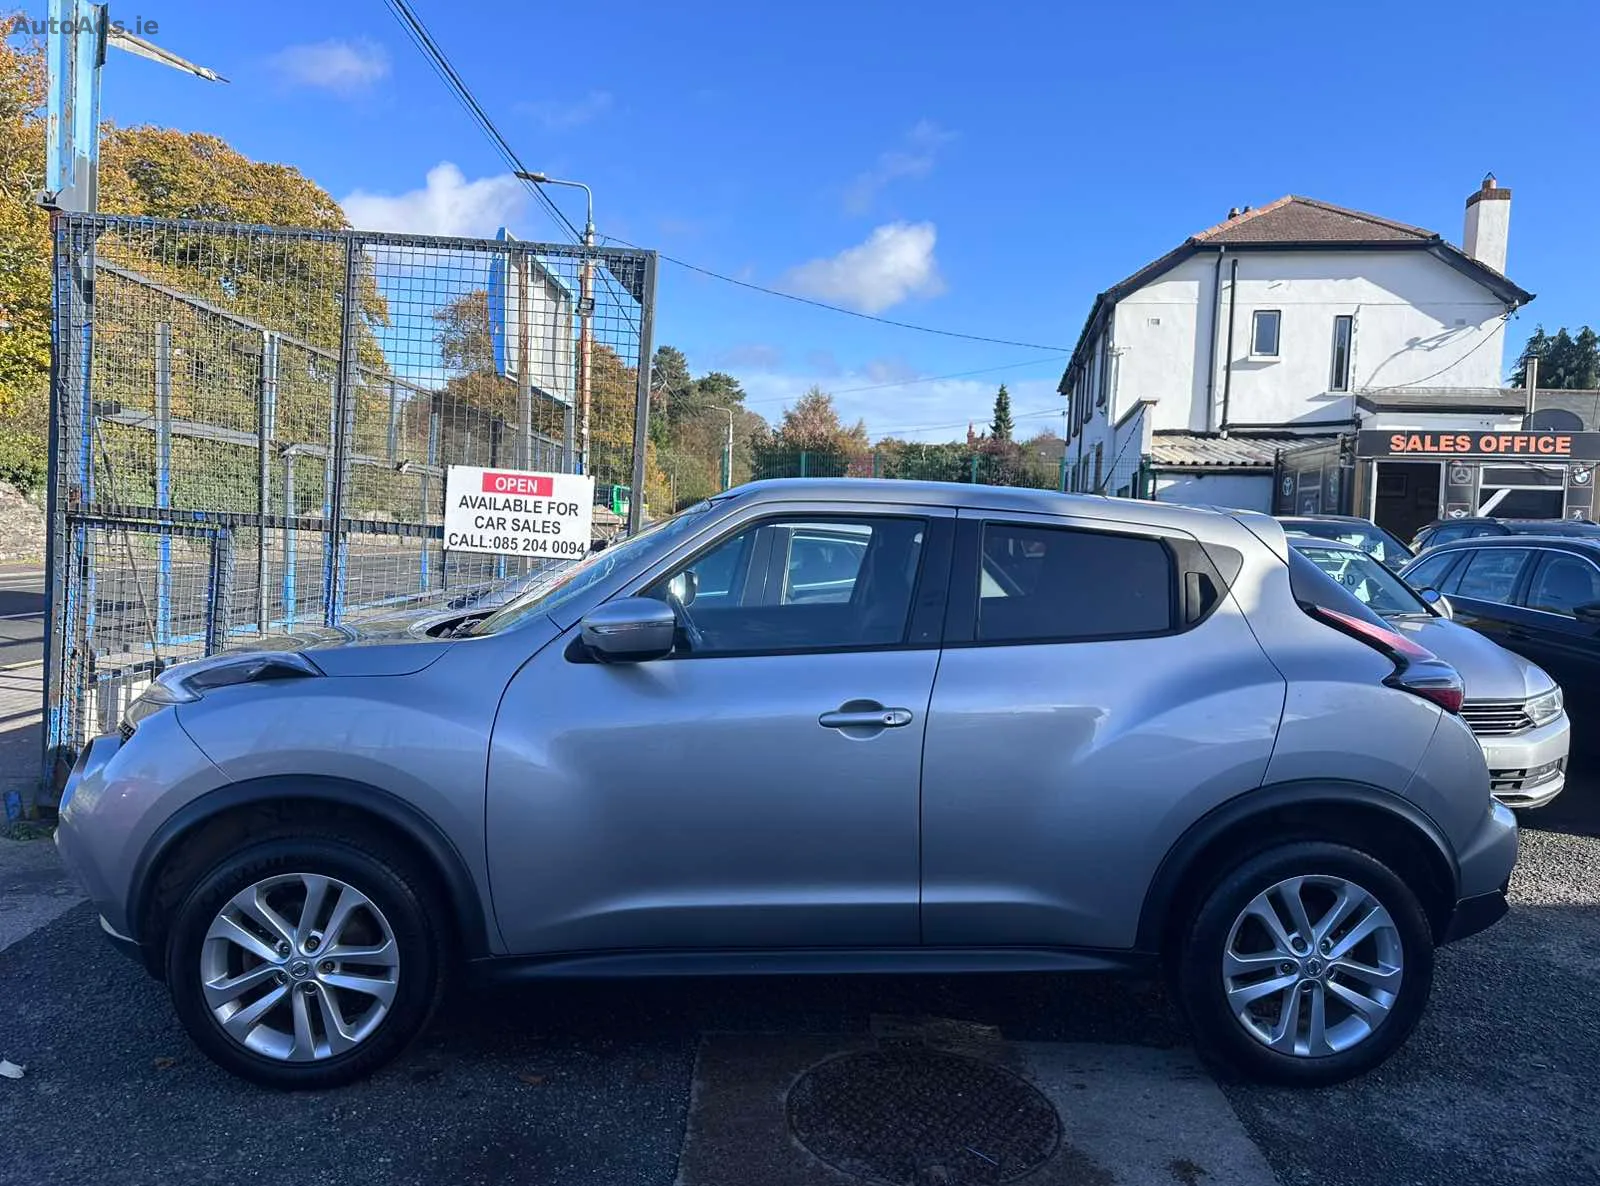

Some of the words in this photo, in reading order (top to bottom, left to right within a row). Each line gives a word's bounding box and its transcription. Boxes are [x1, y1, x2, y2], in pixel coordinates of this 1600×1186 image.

[1390, 434, 1472, 452] SALES
[1479, 435, 1572, 453] OFFICE
[495, 477, 538, 493] OPEN
[458, 495, 543, 514] AVAILABLE
[547, 501, 579, 517] FOR
[474, 515, 507, 531] CAR
[511, 518, 561, 535] SALES
[448, 532, 518, 550] CALL:085
[522, 538, 547, 552] 204
[552, 540, 585, 555] 0094
